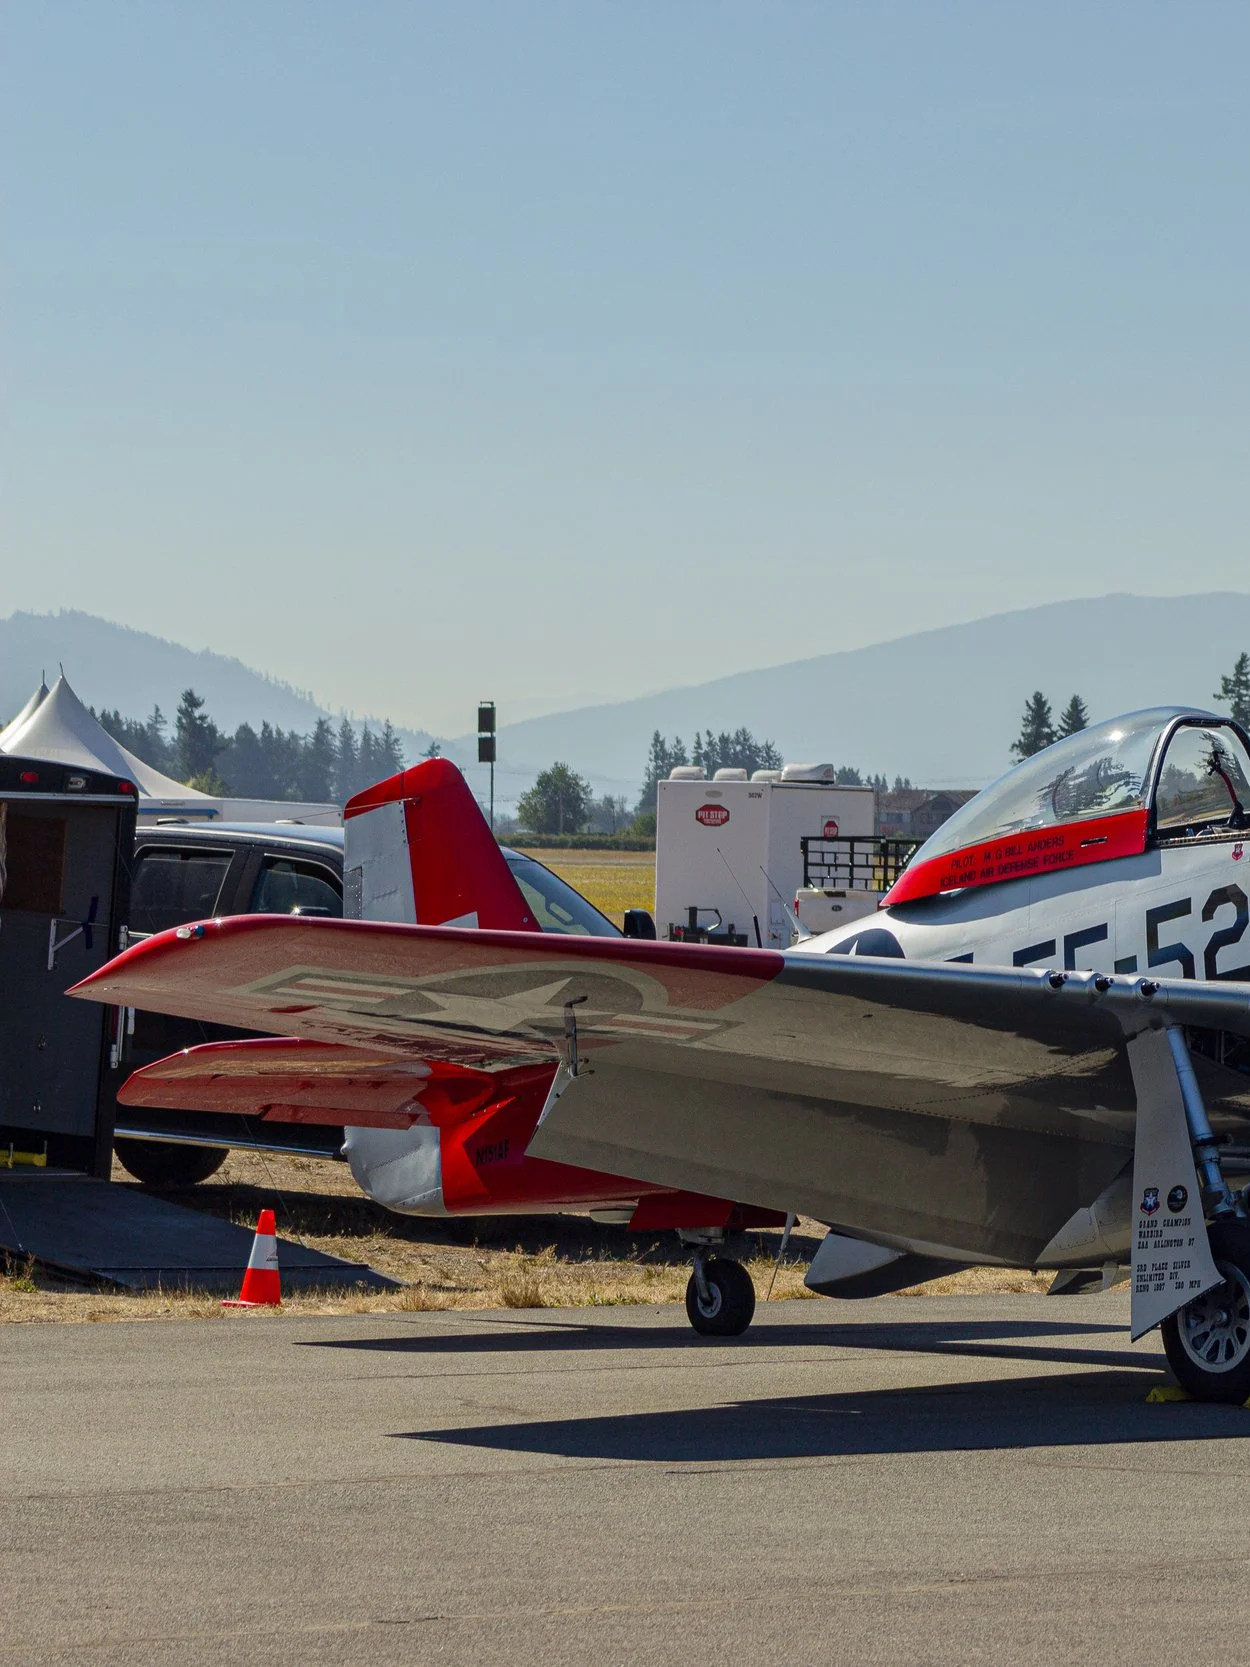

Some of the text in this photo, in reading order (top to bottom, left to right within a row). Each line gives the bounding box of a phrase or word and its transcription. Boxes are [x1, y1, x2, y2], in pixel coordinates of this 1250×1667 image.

[1005, 844, 1025, 858] BILL
[1028, 835, 1065, 852] ANDERS
[940, 850, 1075, 888] ICELAND AIR DEFENSE FORCE
[1139, 1218, 1191, 1228] GRAND CHAMPION
[1138, 1230, 1163, 1239] WARBIRD
[1153, 1239, 1184, 1248] ARLINGTON
[1152, 1262, 1168, 1271] PLACE
[1173, 1260, 1191, 1269] SILVER
[1136, 1273, 1164, 1283] UNLIMITED
[1136, 1284, 1149, 1293] RENO
